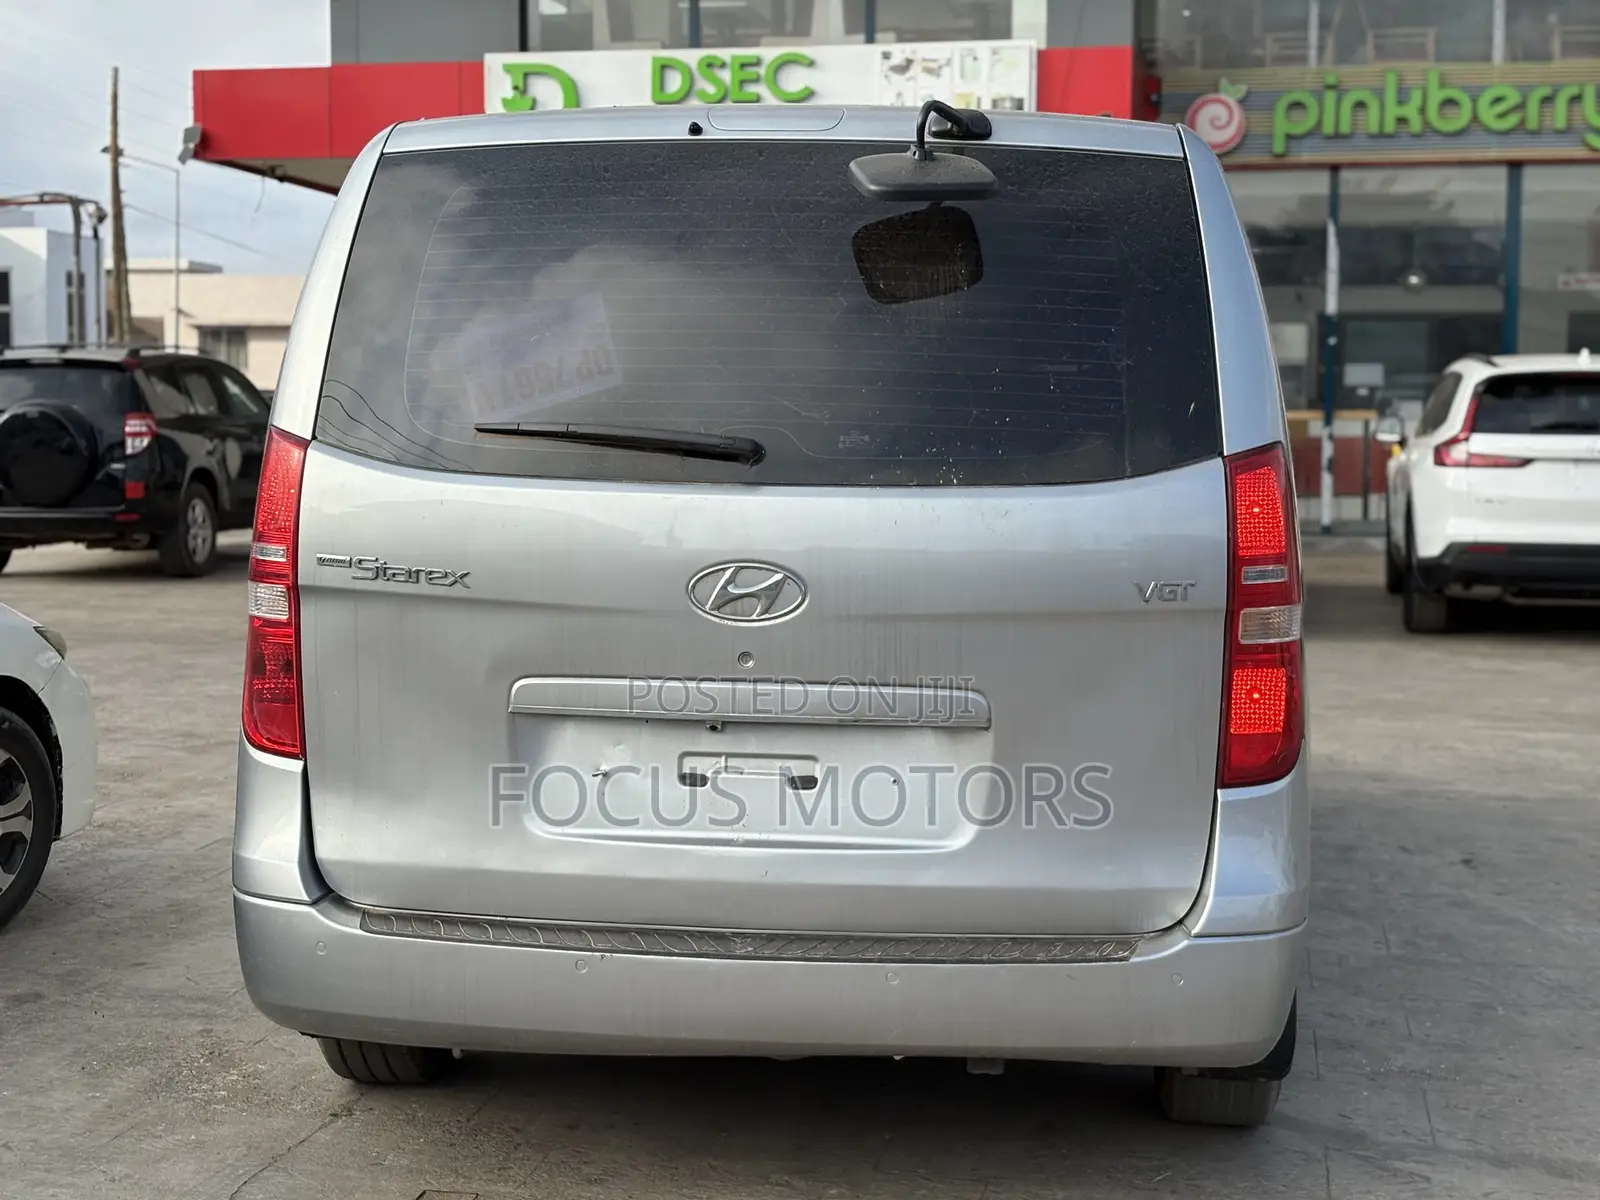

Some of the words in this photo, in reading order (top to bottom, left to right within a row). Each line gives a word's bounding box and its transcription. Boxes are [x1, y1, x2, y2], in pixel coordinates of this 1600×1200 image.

[652, 52, 815, 104] DSEC
[351, 556, 471, 589] Starex
[1133, 580, 1196, 605] VGT
